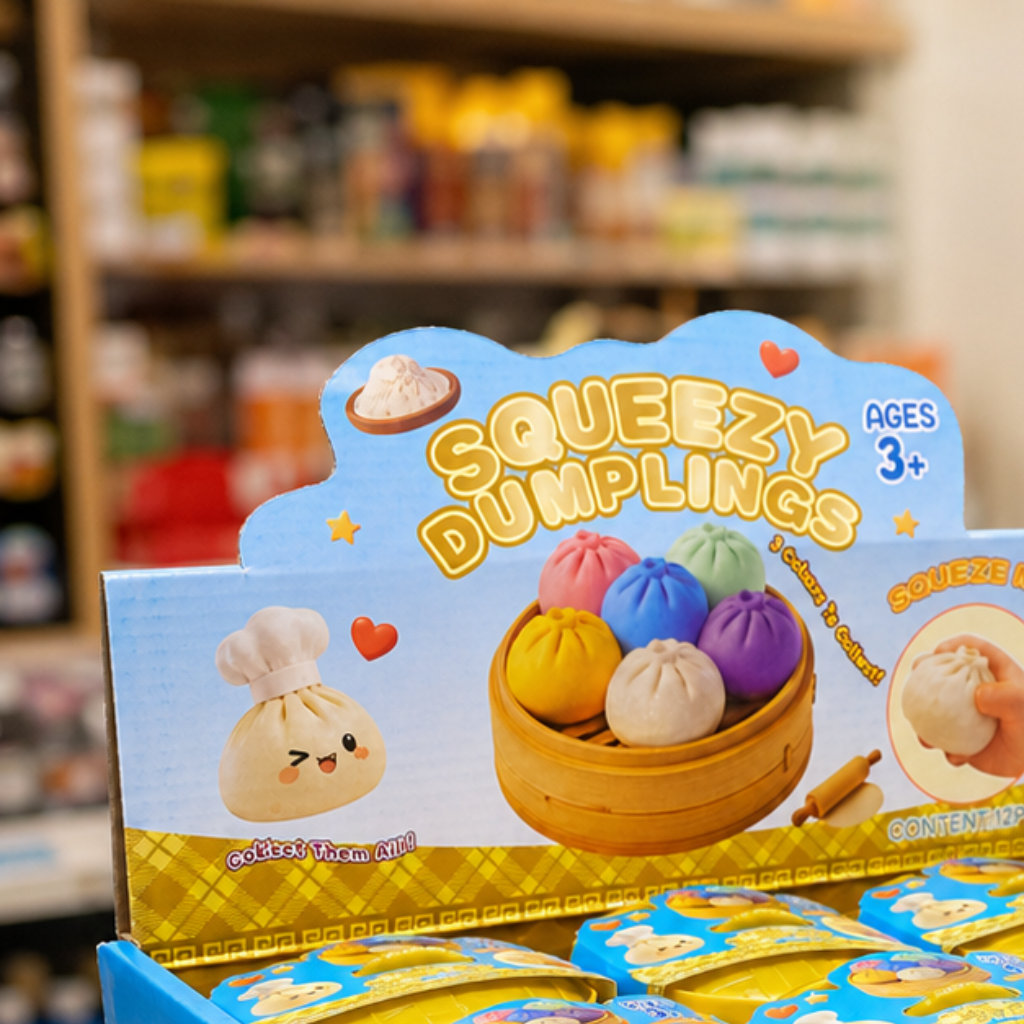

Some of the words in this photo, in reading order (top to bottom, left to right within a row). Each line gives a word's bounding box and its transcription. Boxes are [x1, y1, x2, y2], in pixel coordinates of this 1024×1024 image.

[426, 372, 849, 497] SQUEEZY
[864, 400, 938, 433] AGES
[876, 434, 927, 483] 3+
[417, 451, 862, 580] DUMPLINGS
